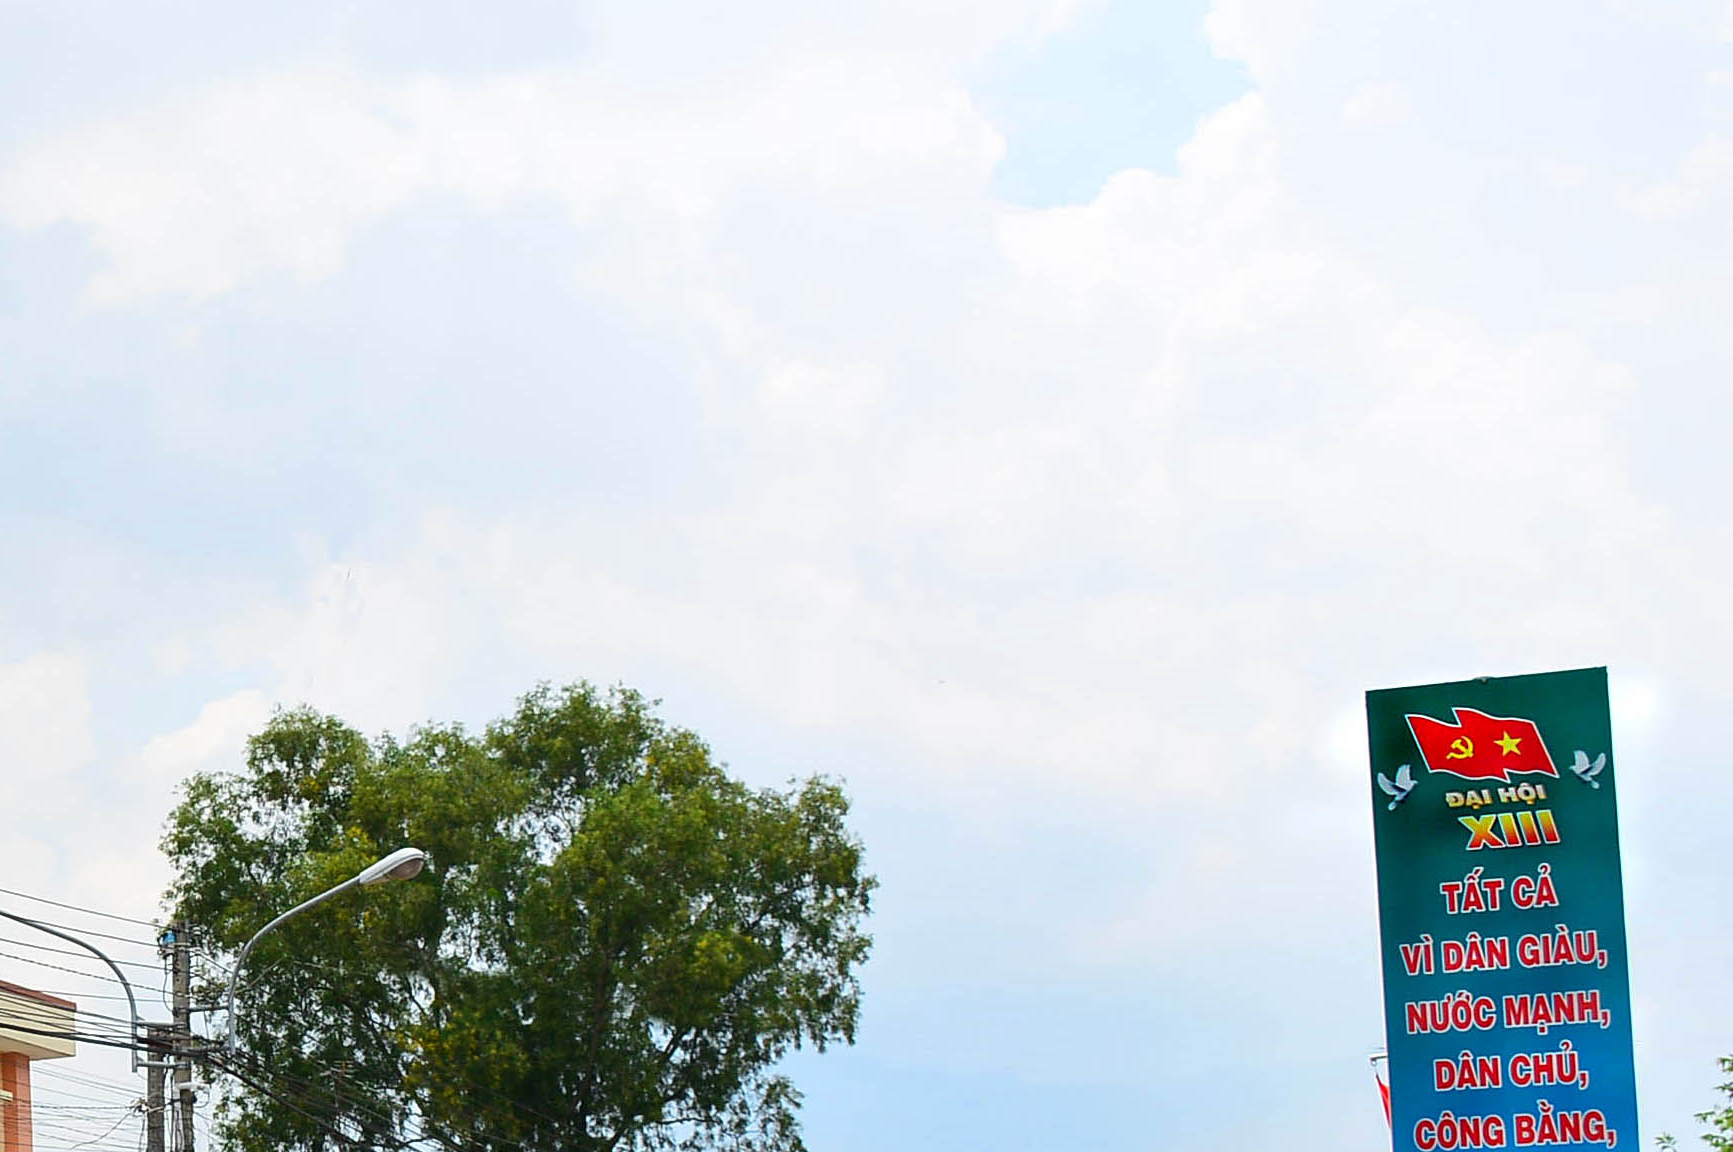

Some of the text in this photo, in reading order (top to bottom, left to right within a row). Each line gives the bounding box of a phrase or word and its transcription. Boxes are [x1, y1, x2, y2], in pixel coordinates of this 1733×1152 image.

[1445, 782, 1547, 809] ĐẠI HỘI
[1458, 809, 1561, 850] XIII
[1440, 863, 1559, 914] TẤT CẢ
[1400, 924, 1607, 975] VÌ DÂN GIÀU,
[1405, 989, 1610, 1035] NƯỚC MẠNH,
[1433, 1040, 1589, 1091] DÂN CHỦ,
[1414, 1099, 1616, 1152] CÔNG BẰNG,
